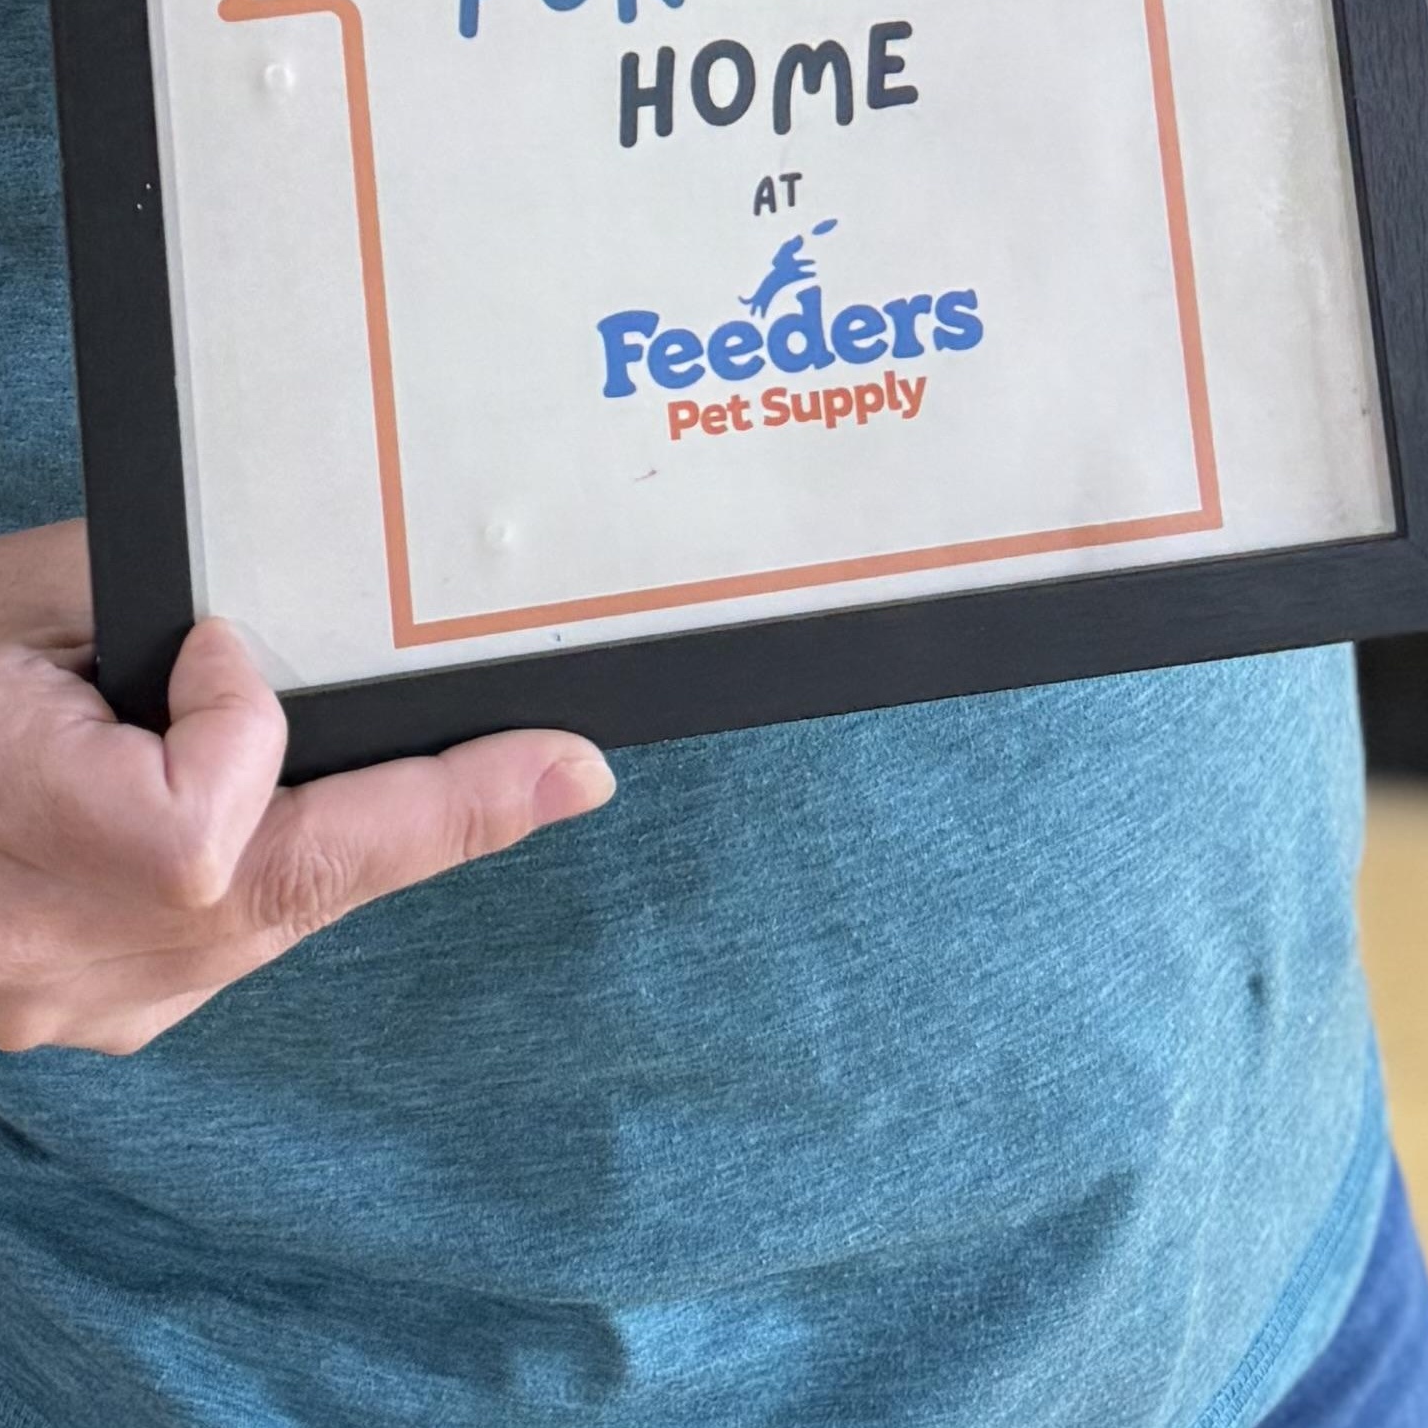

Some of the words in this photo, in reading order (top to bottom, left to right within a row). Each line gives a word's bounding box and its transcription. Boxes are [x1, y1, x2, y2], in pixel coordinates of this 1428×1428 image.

[618, 20, 920, 149] HOME
[753, 171, 803, 217] AT
[596, 286, 984, 399] Feeders
[668, 393, 752, 441] Pet
[762, 370, 928, 431] Supply
